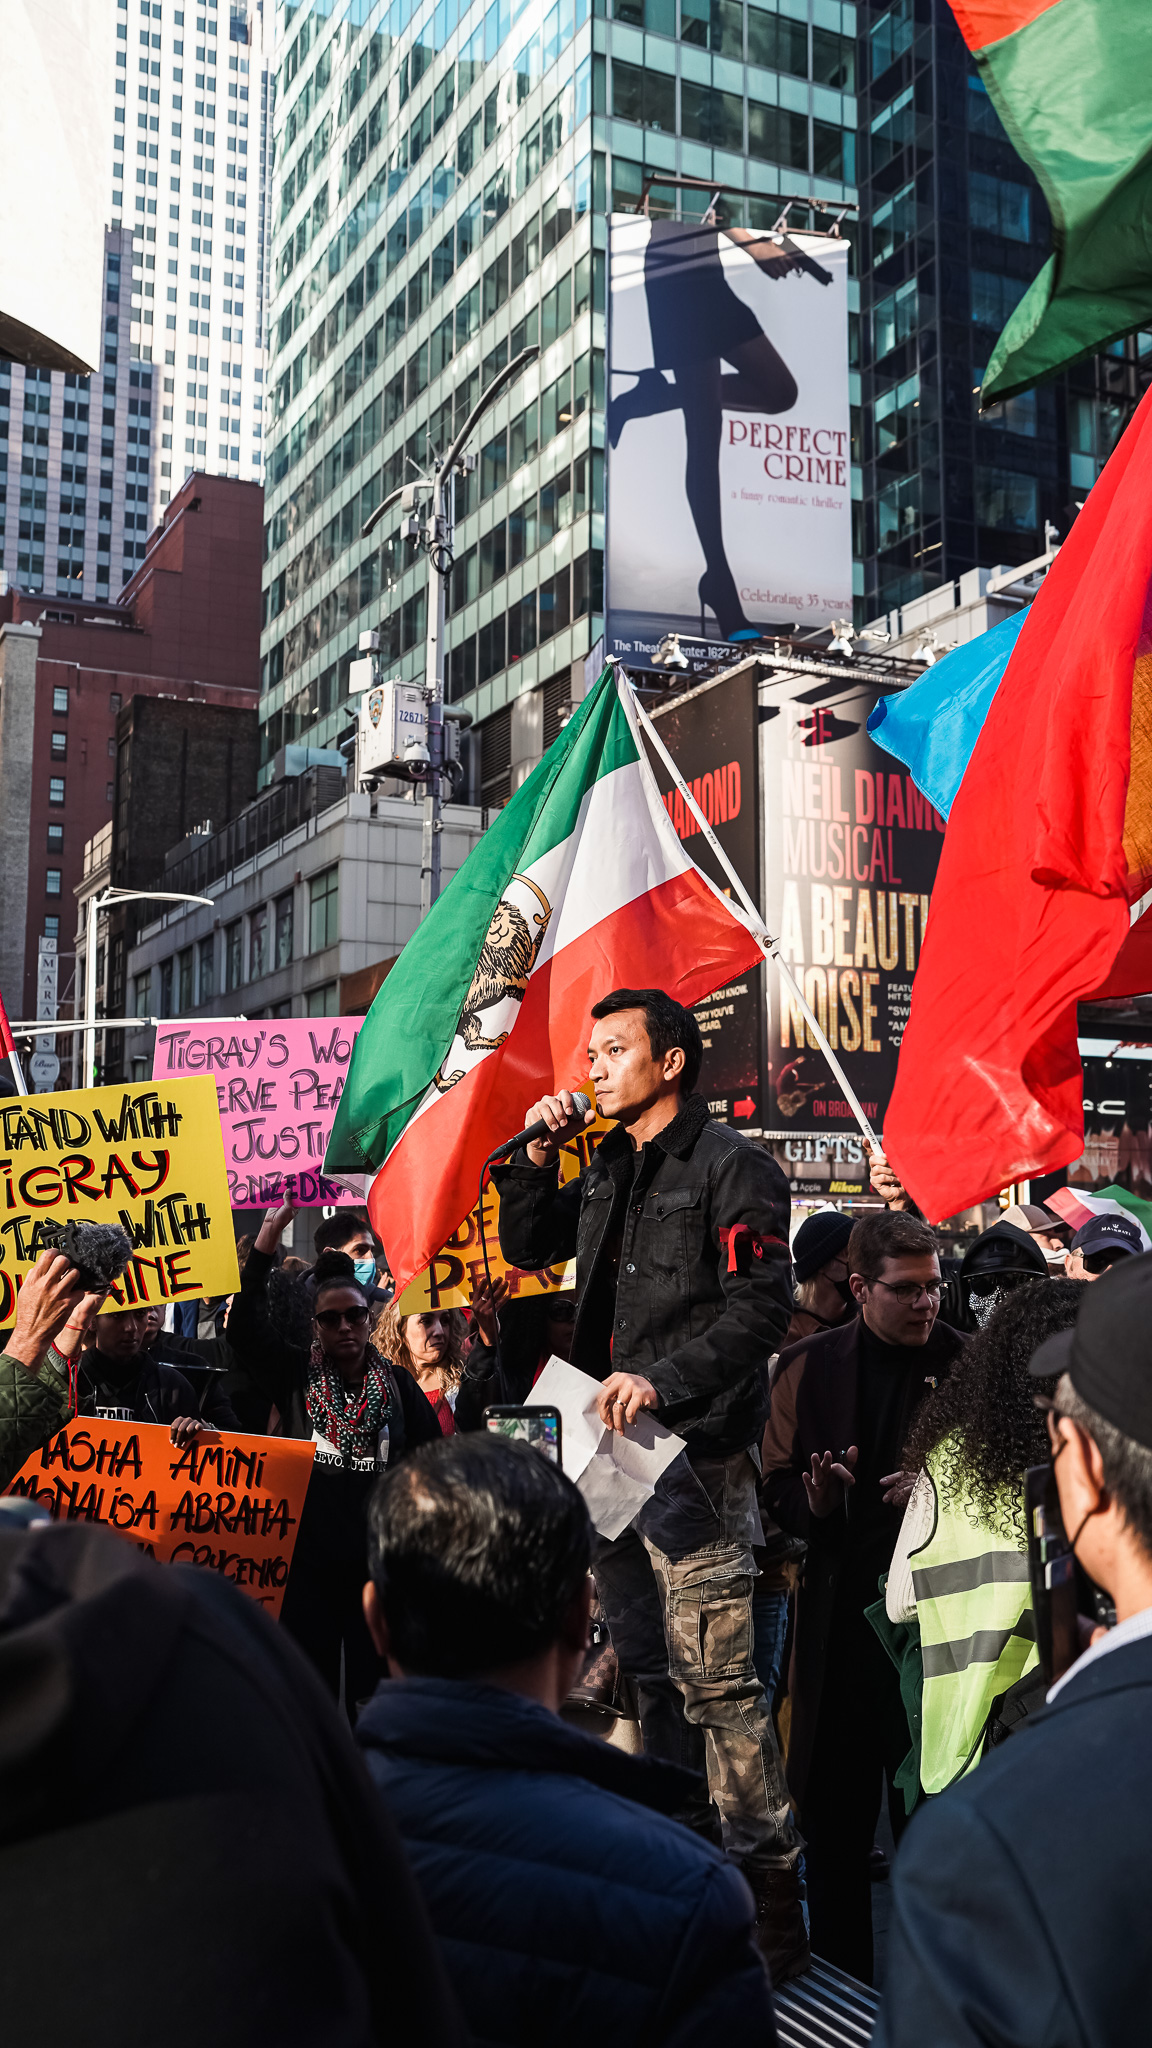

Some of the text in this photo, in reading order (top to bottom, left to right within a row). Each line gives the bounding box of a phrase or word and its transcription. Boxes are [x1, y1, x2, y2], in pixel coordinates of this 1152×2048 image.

[728, 420, 848, 457] PERFECT
[764, 453, 847, 487] CRIME
[731, 489, 843, 510] a funny romantic thriller
[740, 588, 804, 610] Celebrating
[613, 639, 632, 653] The
[399, 710, 424, 724] 72671
[781, 703, 834, 763] THE
[781, 759, 850, 823] NEIL
[782, 816, 902, 884] MUSICAL
[780, 880, 805, 965] A
[712, 990, 726, 1001] YOU
[780, 965, 881, 1053] NOISE
[887, 993, 901, 1001] HIT
[694, 1010, 710, 1022] TORY
[216, 1077, 278, 1115] ERVE
[813, 1100, 878, 1119] ON BROAWAY
[0, 1092, 183, 1151] TAND WITH
[784, 1138, 863, 1163] GIFTS
[800, 1183, 822, 1192] Apple
[829, 1181, 863, 1193] Nikon
[118, 1192, 211, 1251] WITH
[170, 1490, 296, 1541] ABRAHA
